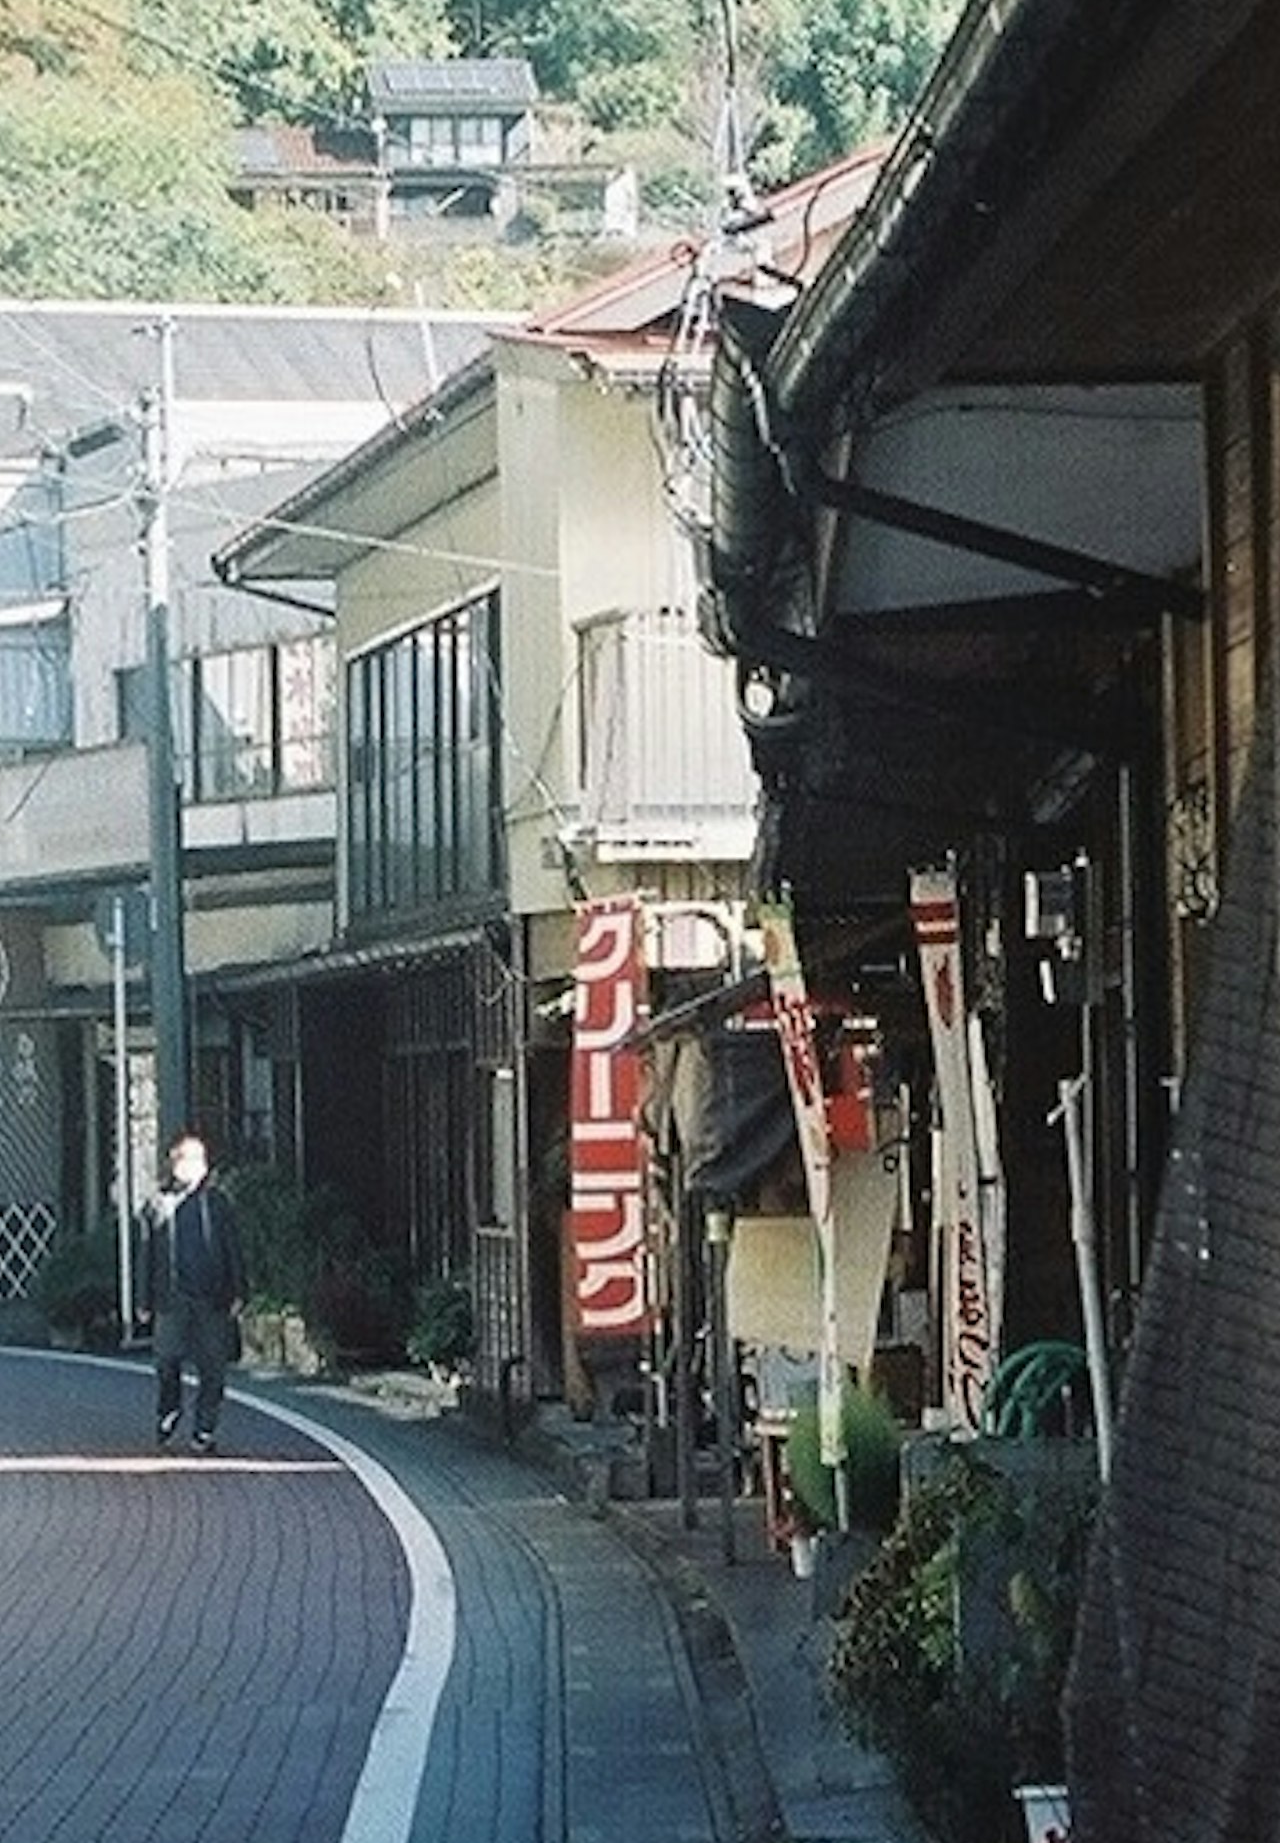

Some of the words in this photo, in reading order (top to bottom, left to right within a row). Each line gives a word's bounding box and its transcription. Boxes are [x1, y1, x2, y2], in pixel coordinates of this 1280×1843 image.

[570, 913, 646, 1328] クリーニング
